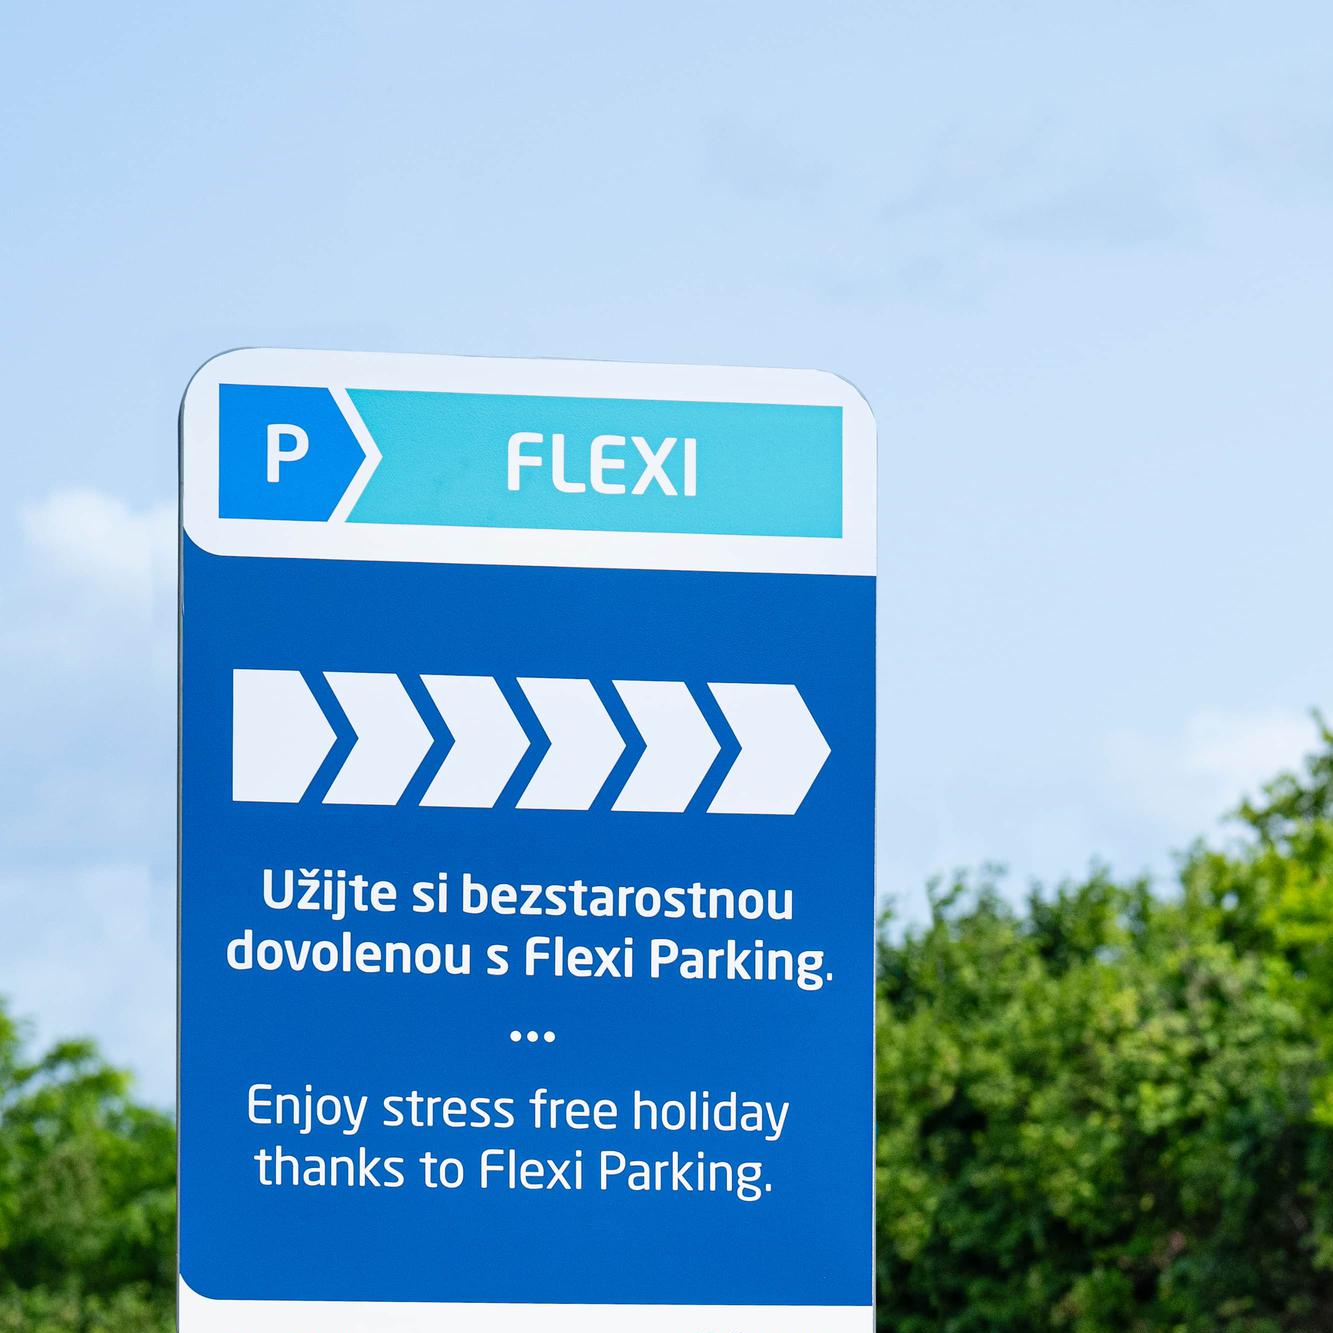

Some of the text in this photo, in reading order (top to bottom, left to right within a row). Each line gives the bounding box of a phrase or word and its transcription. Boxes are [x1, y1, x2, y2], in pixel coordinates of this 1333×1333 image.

[266, 423, 698, 497] P FLEXI
[263, 867, 793, 921] Užijte si bezstarostnou
[226, 929, 833, 991] dovolenou s Flexi Parking.
[248, 1083, 790, 1142] Enjoy stress free holiday
[253, 1145, 772, 1202] thanks to Flexi Parking.
